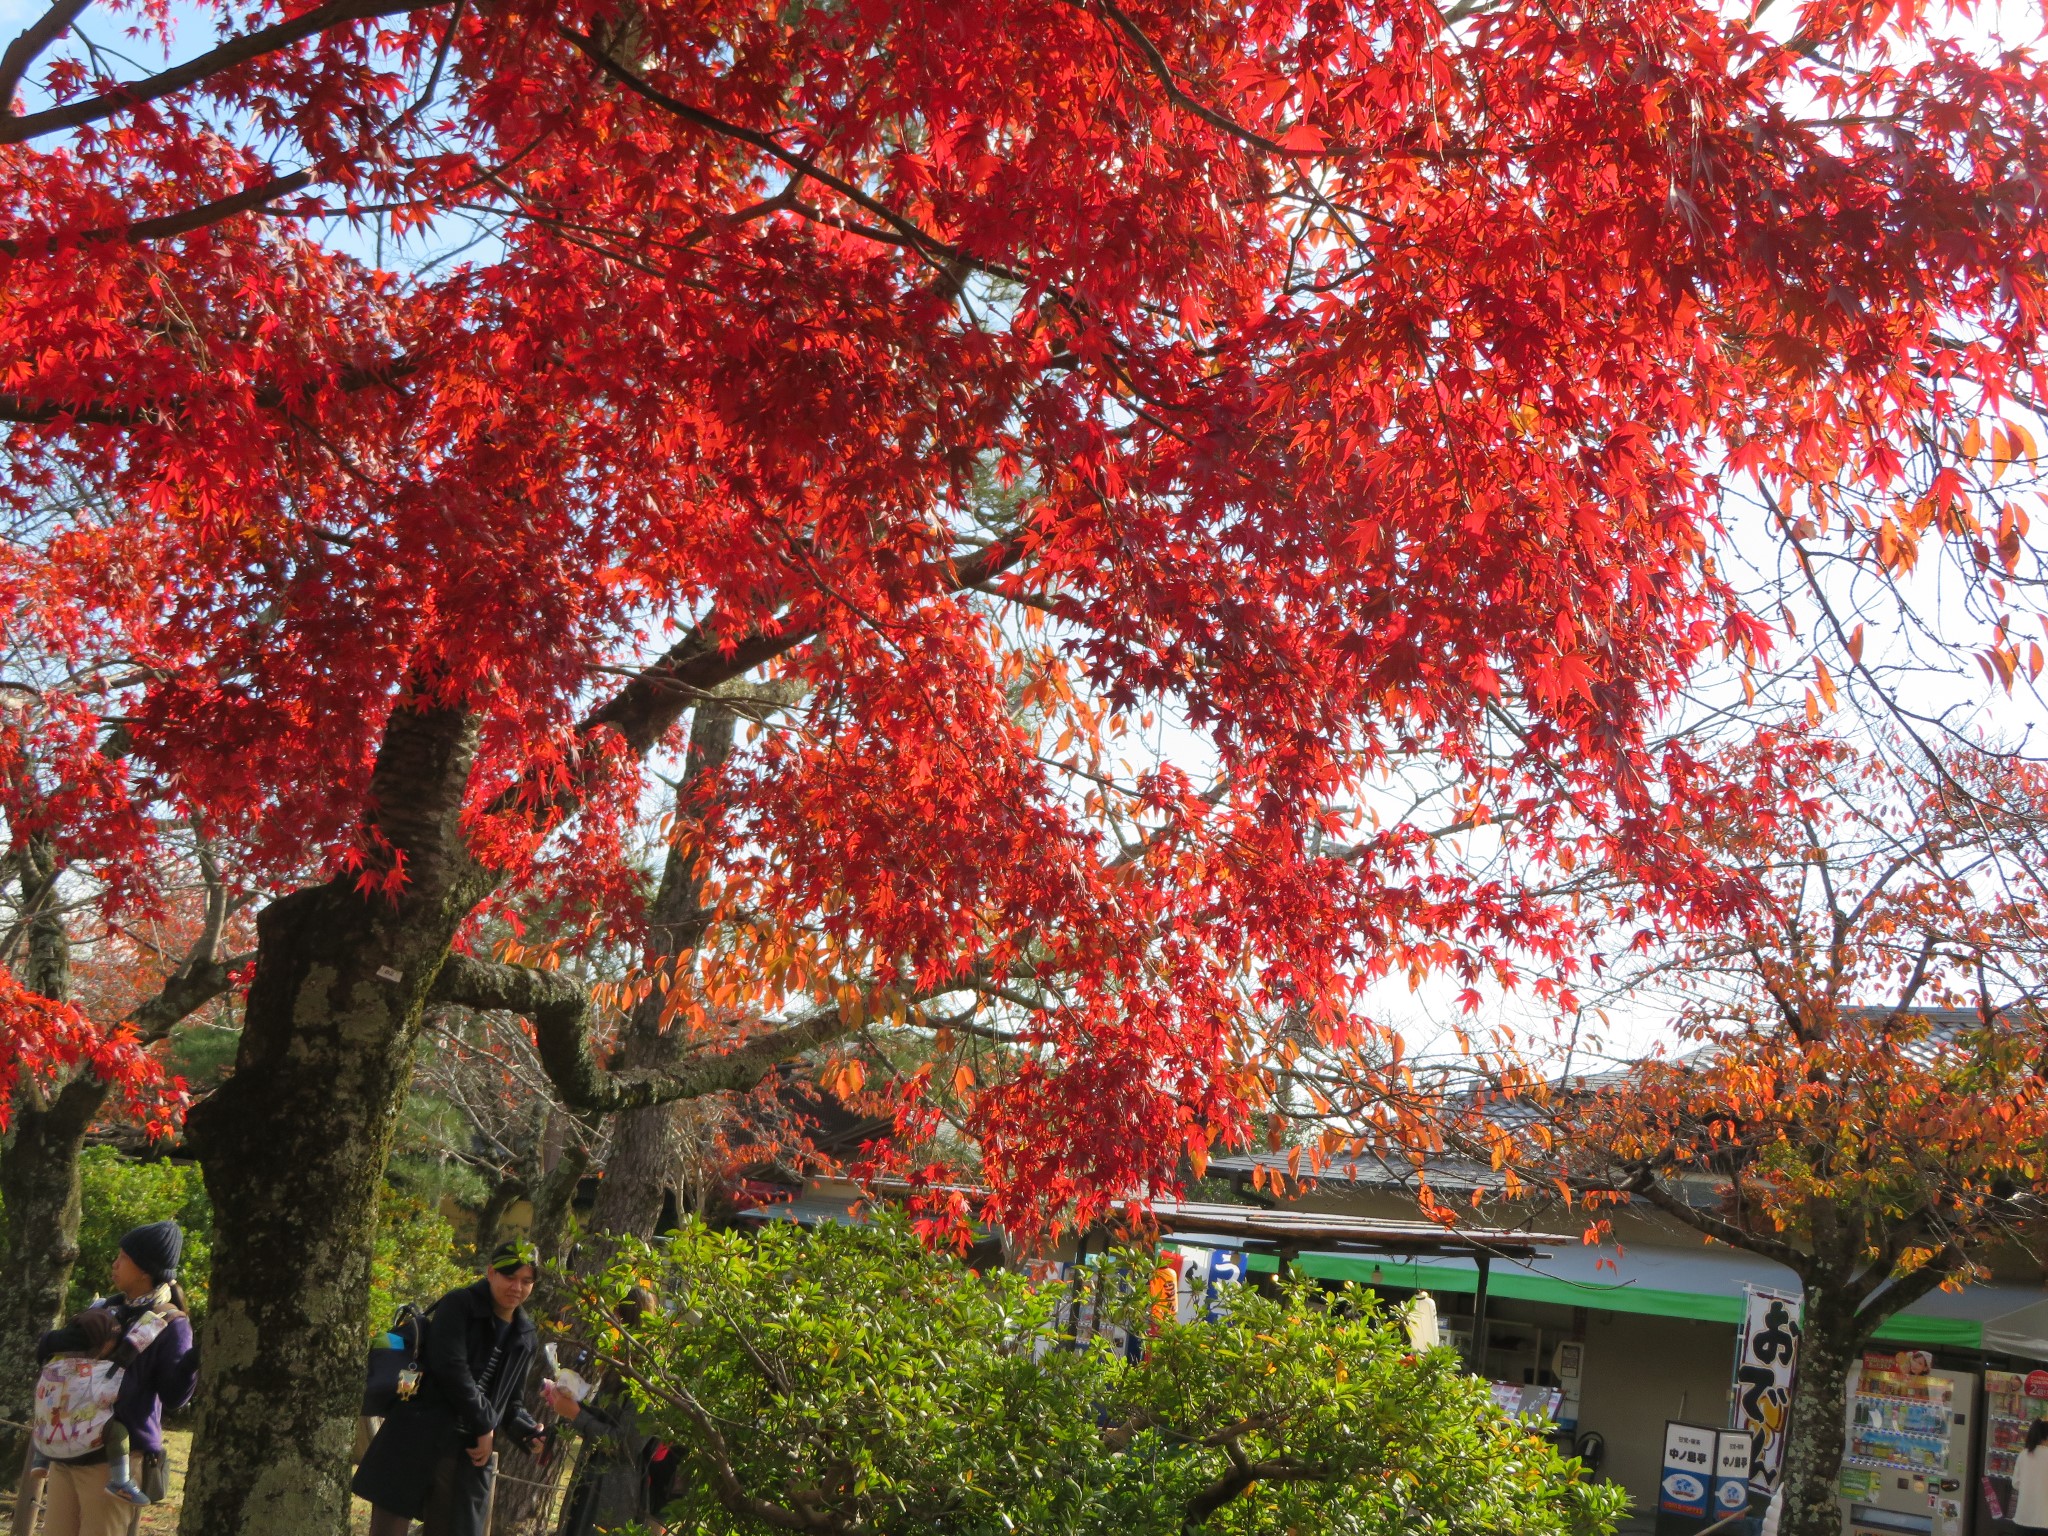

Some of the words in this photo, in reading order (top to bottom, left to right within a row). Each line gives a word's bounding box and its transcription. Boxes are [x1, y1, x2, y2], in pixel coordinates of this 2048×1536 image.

[1739, 1300, 1799, 1486] おでん
[1669, 1448, 1707, 1465] 中ノ島亭
[1722, 1456, 1748, 1468] 中ノ島亭
